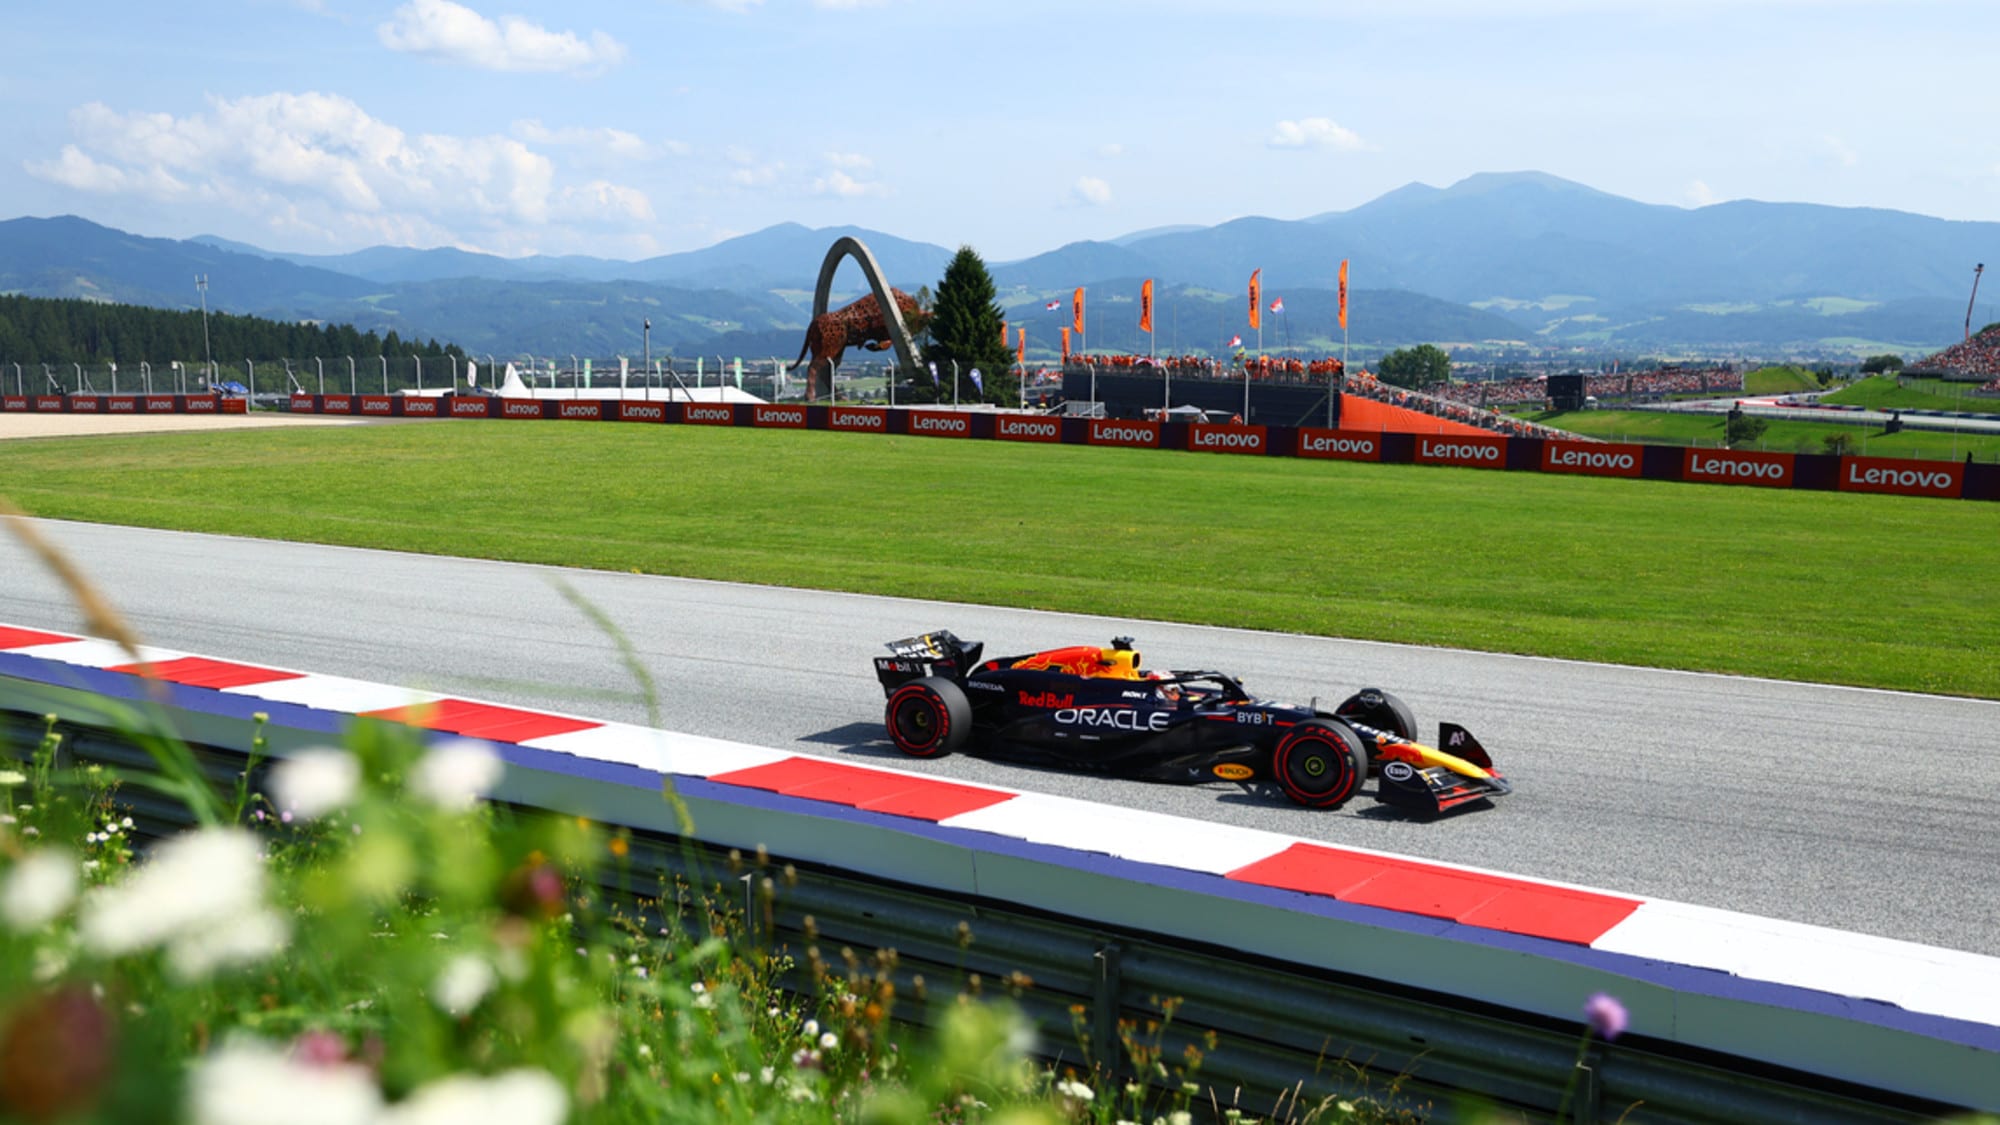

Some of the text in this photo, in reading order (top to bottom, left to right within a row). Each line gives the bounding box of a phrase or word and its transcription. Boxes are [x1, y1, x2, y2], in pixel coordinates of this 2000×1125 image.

[362, 400, 390, 411] Lenovo
[405, 401, 434, 412] Lenovo
[453, 402, 485, 413] Lenovo
[505, 402, 540, 415] Lenovo
[561, 404, 598, 417] Lenovo
[622, 405, 661, 419] Lenovo
[688, 407, 729, 421] Lenovo
[757, 410, 802, 424] Lenovo
[833, 412, 881, 427] Lenovo
[914, 415, 965, 431] Lenovo
[1000, 418, 1056, 436] Lenovo
[1093, 422, 1154, 442] Lenovo
[1194, 427, 1260, 447] Lenovo
[1303, 433, 1374, 454] Lenovo
[1422, 441, 1499, 461] Lenovo
[1550, 447, 1634, 469] Lenovo
[1691, 455, 1784, 479] Lenovo
[1849, 463, 1951, 488] Lenovo
[968, 681, 1005, 692] HONDA
[1018, 690, 1074, 708] Red Bull
[1054, 708, 1170, 731] ORACLE
[1237, 711, 1274, 726] BYBIT
